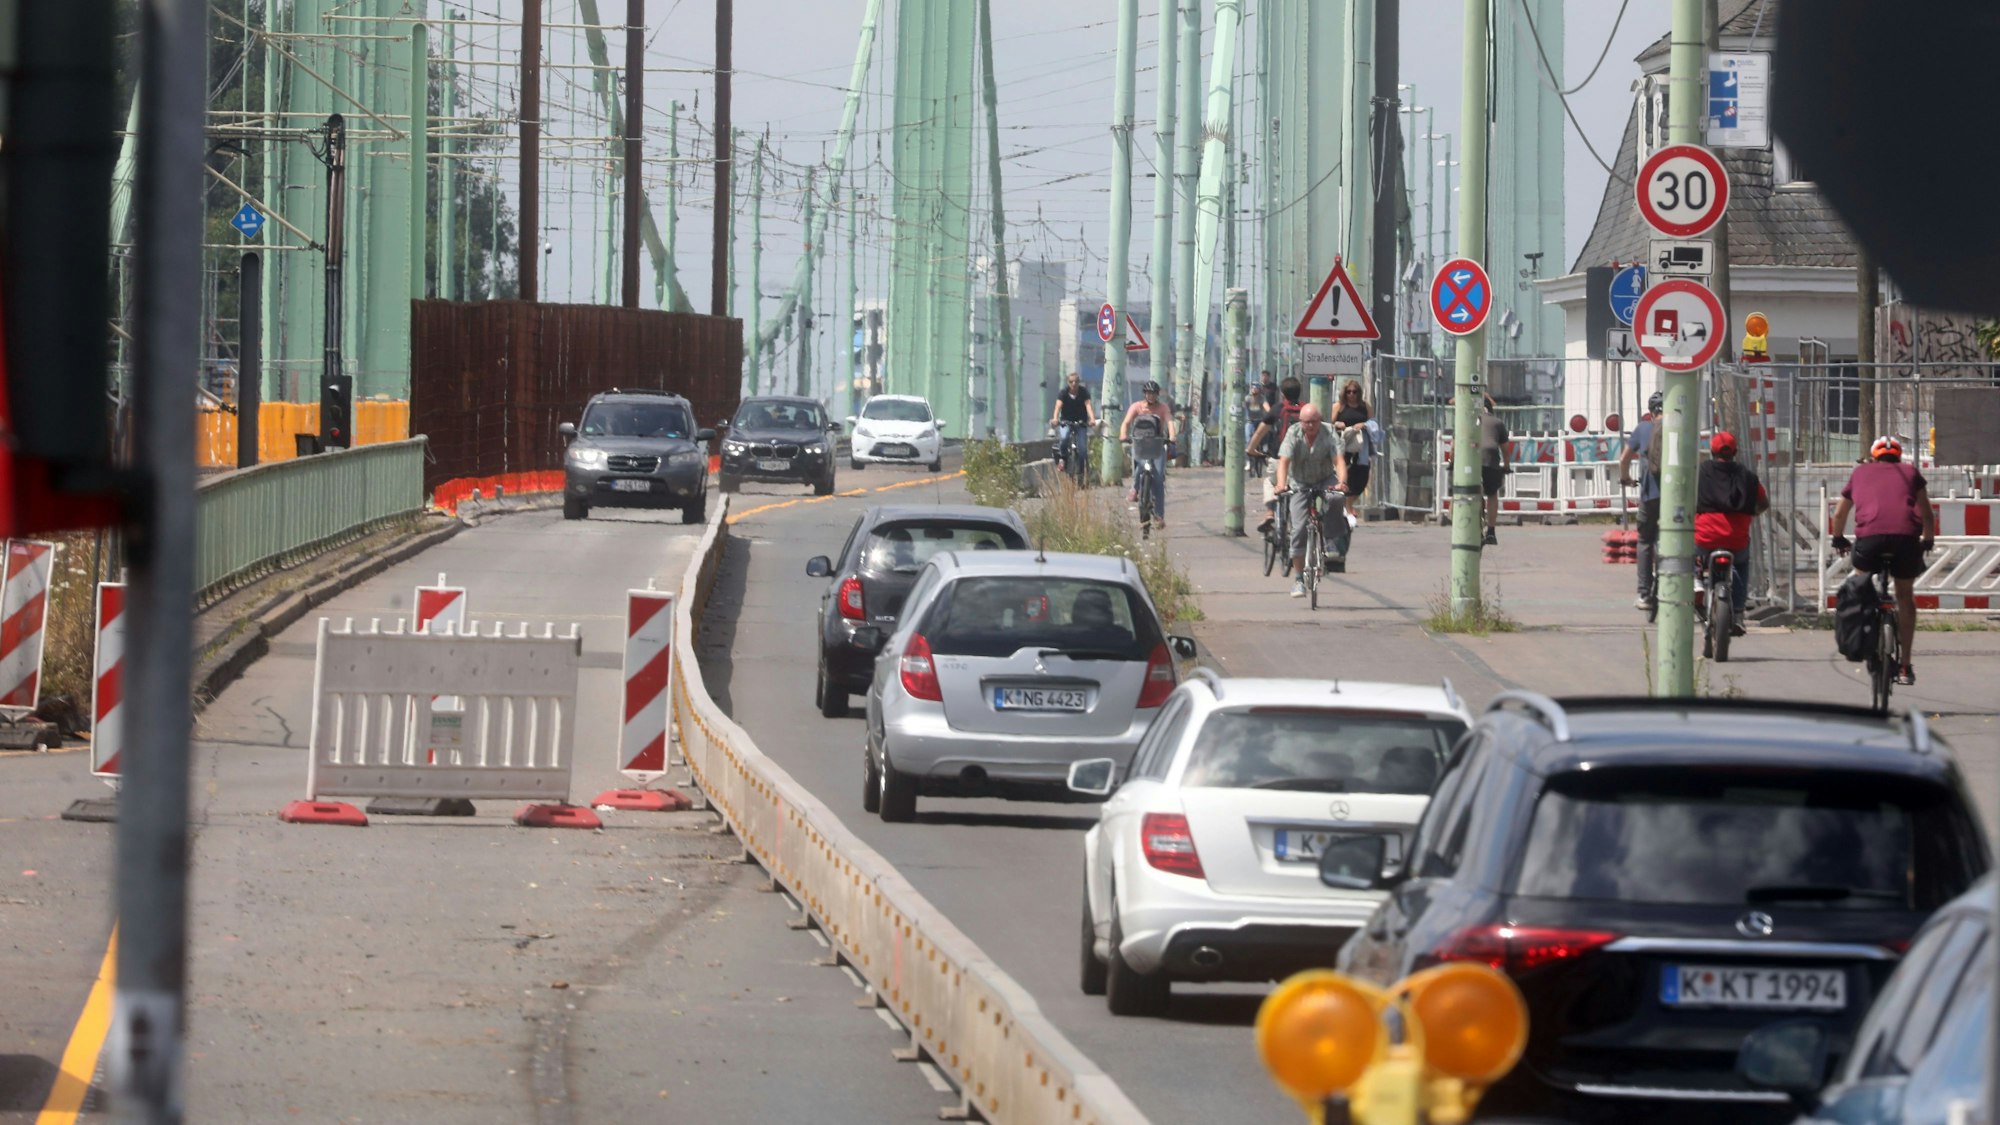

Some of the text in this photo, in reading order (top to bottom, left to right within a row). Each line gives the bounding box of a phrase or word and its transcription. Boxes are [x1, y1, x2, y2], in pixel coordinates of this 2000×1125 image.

[1657, 171, 1707, 211] 30
[1306, 352, 1358, 363] Straßenschäden
[1004, 690, 1084, 707] K NG 4423
[1301, 834, 1314, 853] K
[1682, 972, 1838, 1002] K KT 1994
